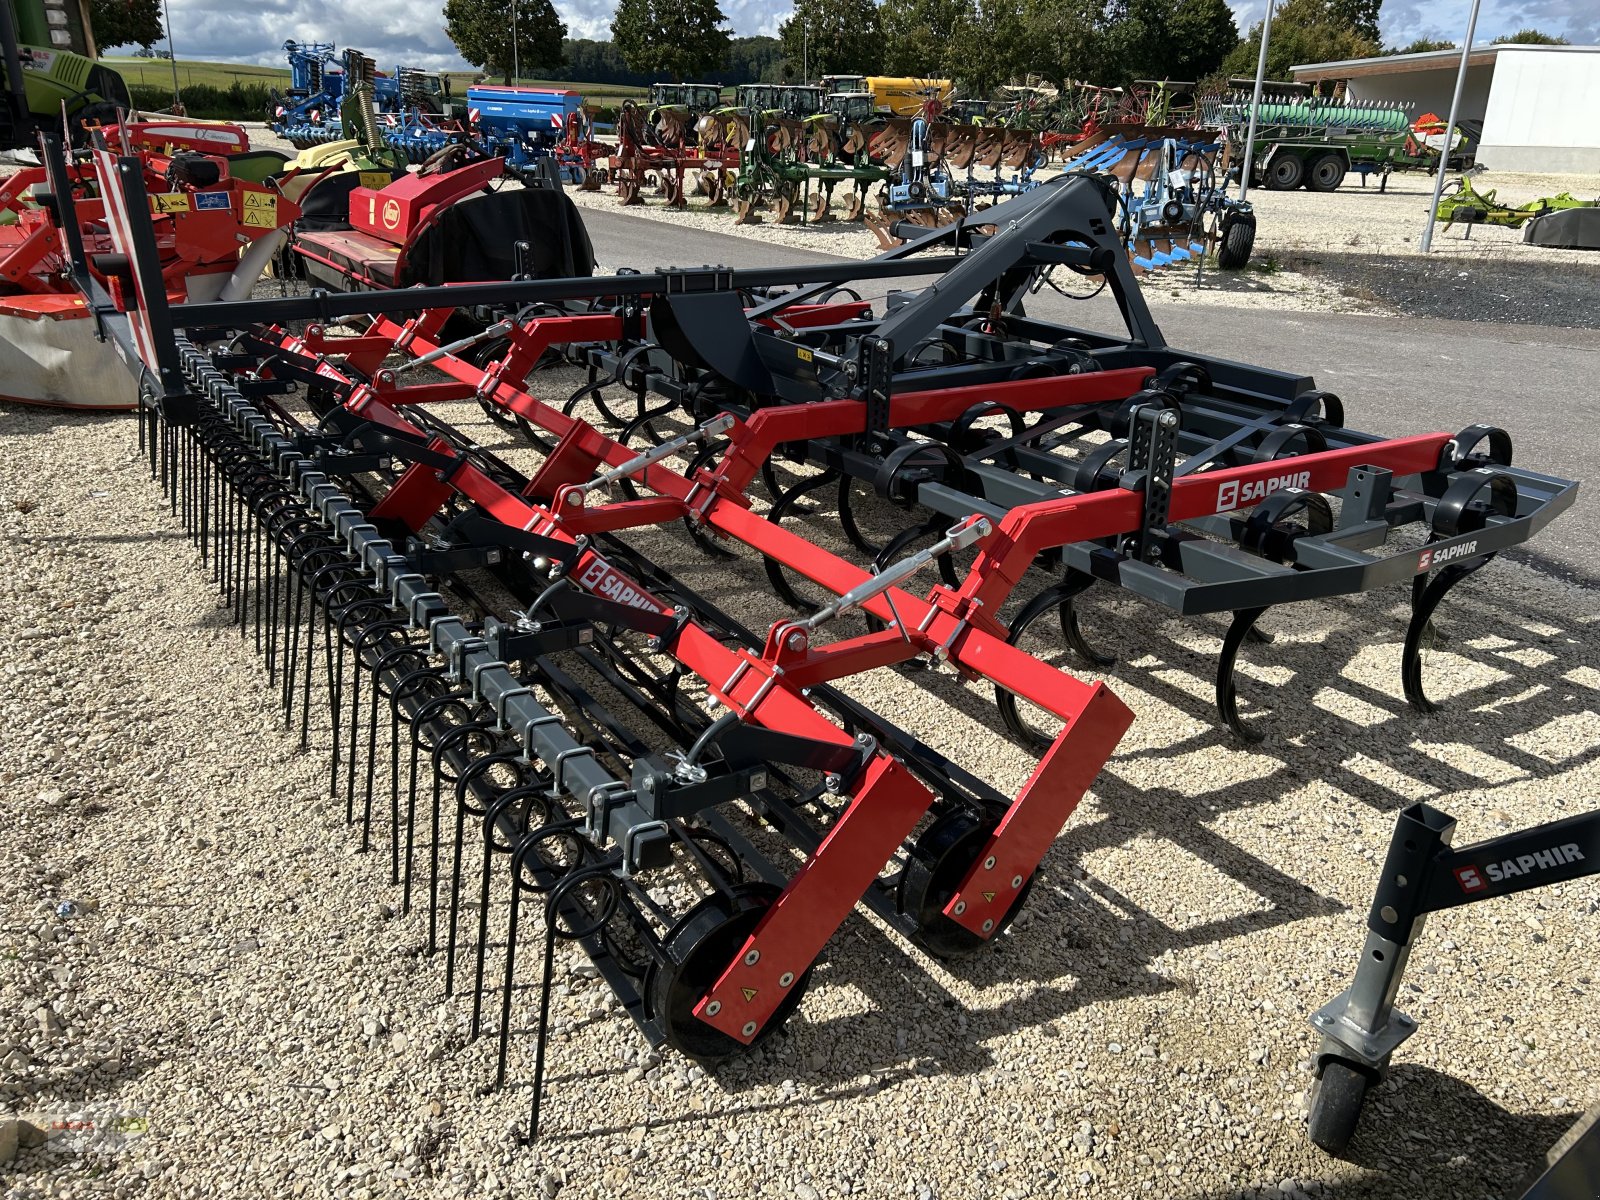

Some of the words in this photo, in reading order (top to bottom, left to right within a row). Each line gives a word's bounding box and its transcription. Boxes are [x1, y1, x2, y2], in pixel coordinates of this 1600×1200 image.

[1240, 471, 1311, 502] SAPHIR
[1432, 541, 1478, 564] SAPHIR
[1485, 843, 1586, 882] SAPHIR
